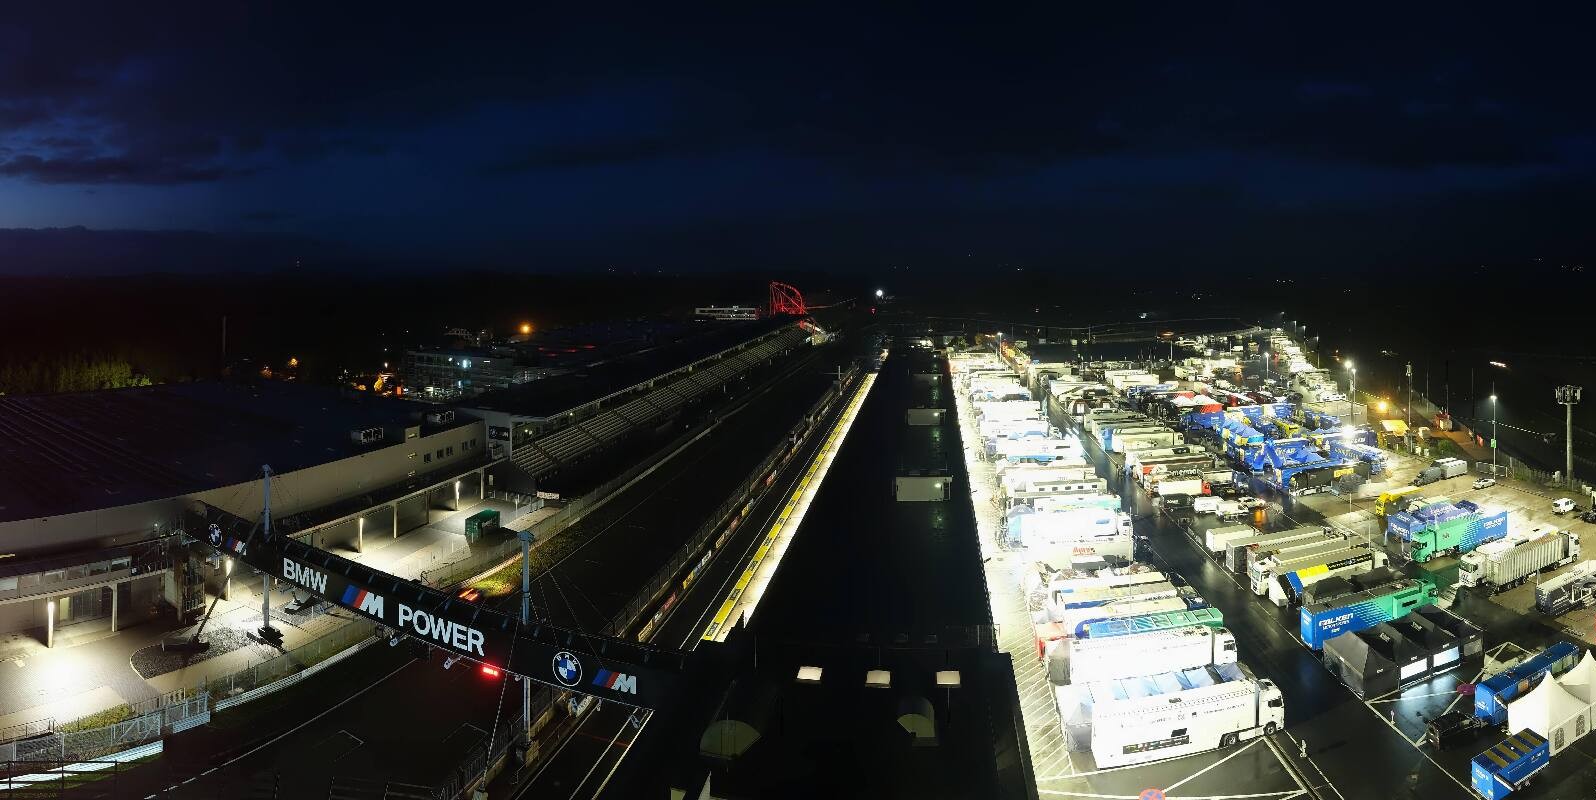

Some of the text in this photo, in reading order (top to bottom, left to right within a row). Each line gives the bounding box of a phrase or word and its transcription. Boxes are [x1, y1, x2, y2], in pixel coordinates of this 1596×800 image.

[283, 557, 328, 595] BMW
[398, 603, 485, 657] POWER
[1318, 612, 1354, 627] FALKEN
